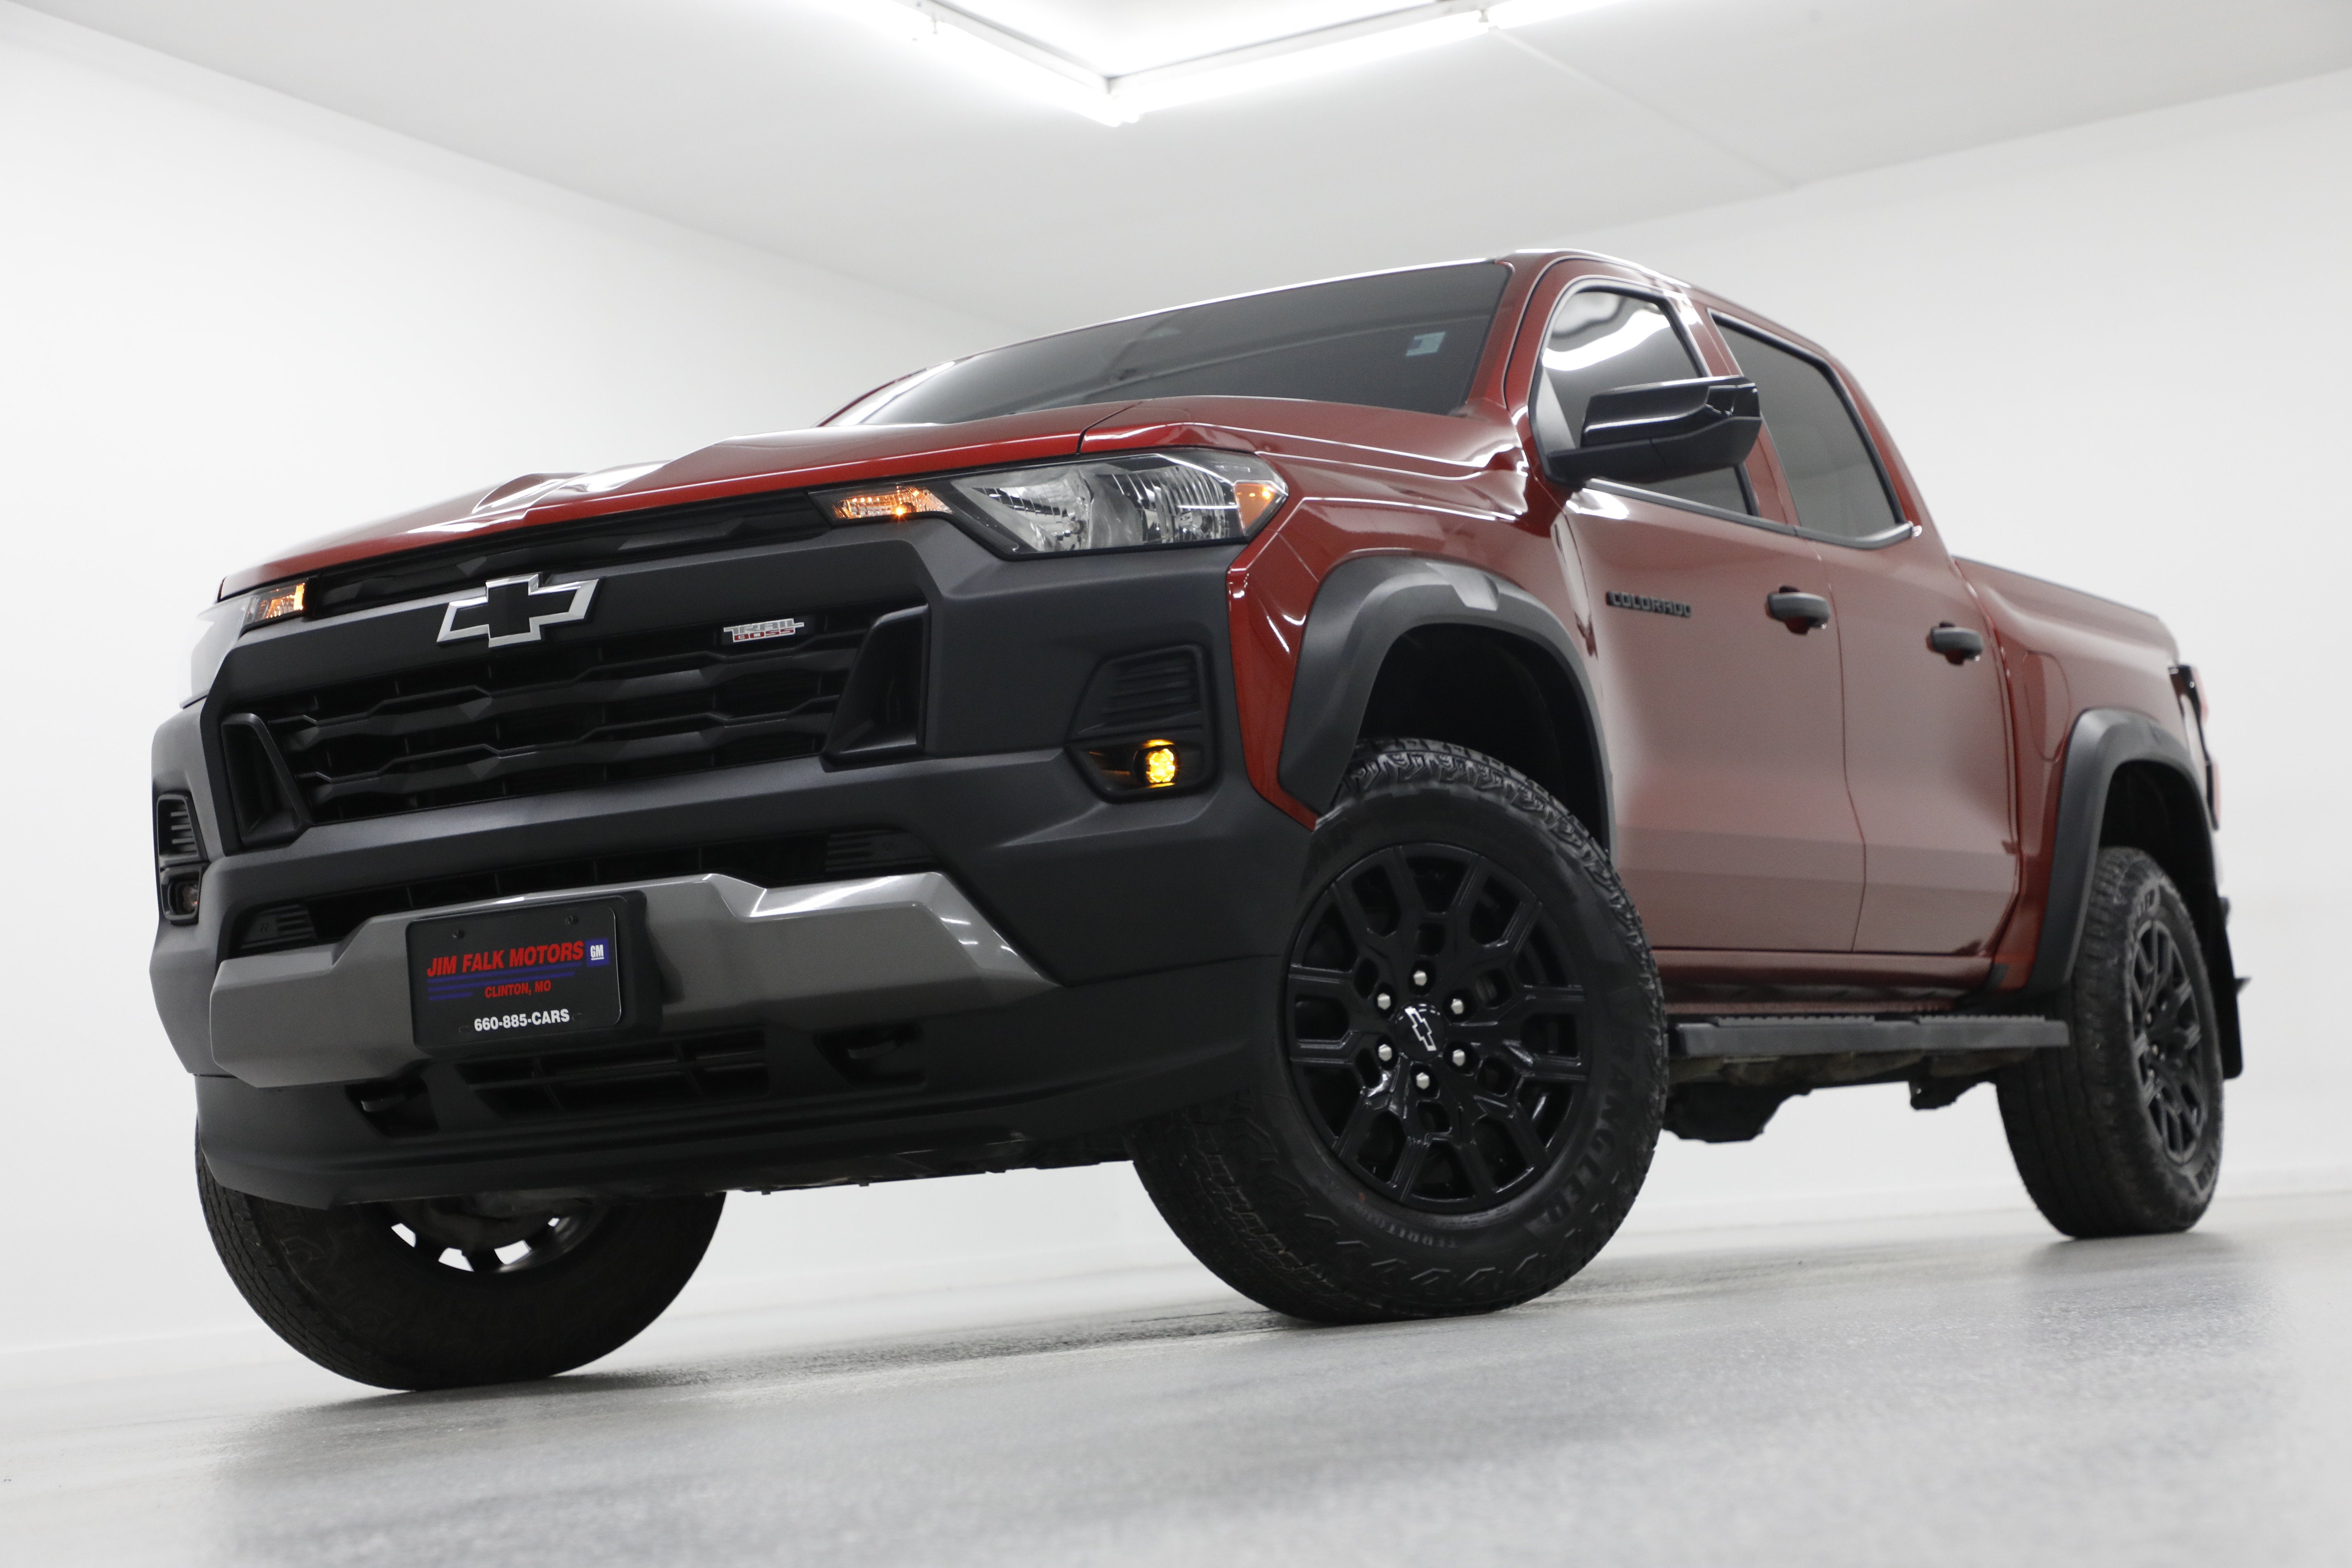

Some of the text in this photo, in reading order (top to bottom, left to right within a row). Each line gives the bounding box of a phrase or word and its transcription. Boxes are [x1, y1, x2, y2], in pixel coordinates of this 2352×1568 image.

[1606, 591, 1691, 618] COLORADO
[723, 618, 804, 634] TRAIL
[733, 626, 796, 642] BOSS
[427, 940, 584, 977] JIM FALK MOTORS
[590, 944, 604, 959] GM
[484, 980, 552, 998] CLINTON, MO
[474, 1008, 570, 1032] 660-885-CARS
